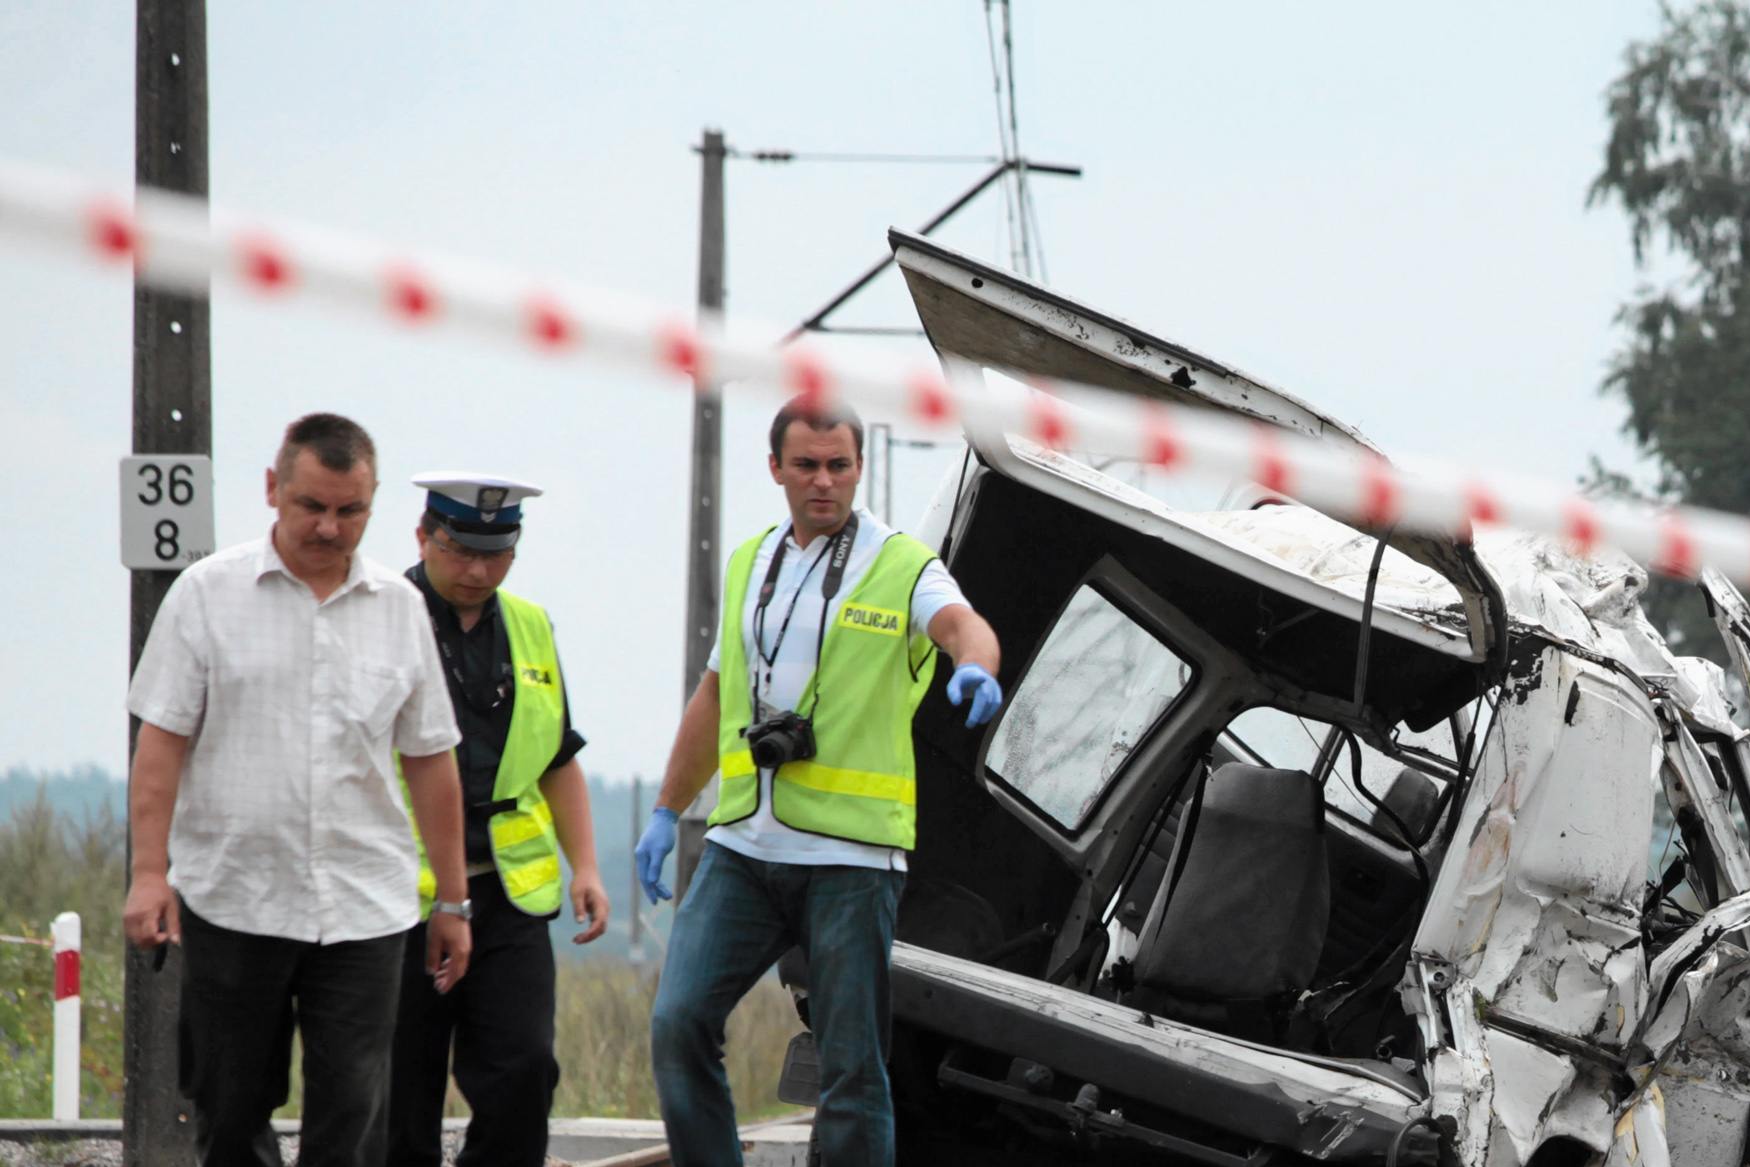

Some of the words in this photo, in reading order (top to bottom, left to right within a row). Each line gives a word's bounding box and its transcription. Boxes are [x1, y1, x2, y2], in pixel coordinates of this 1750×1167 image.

[138, 463, 194, 506] 36
[154, 518, 180, 561] 8
[832, 534, 851, 568] SONY
[843, 607, 899, 631] POLICJA
